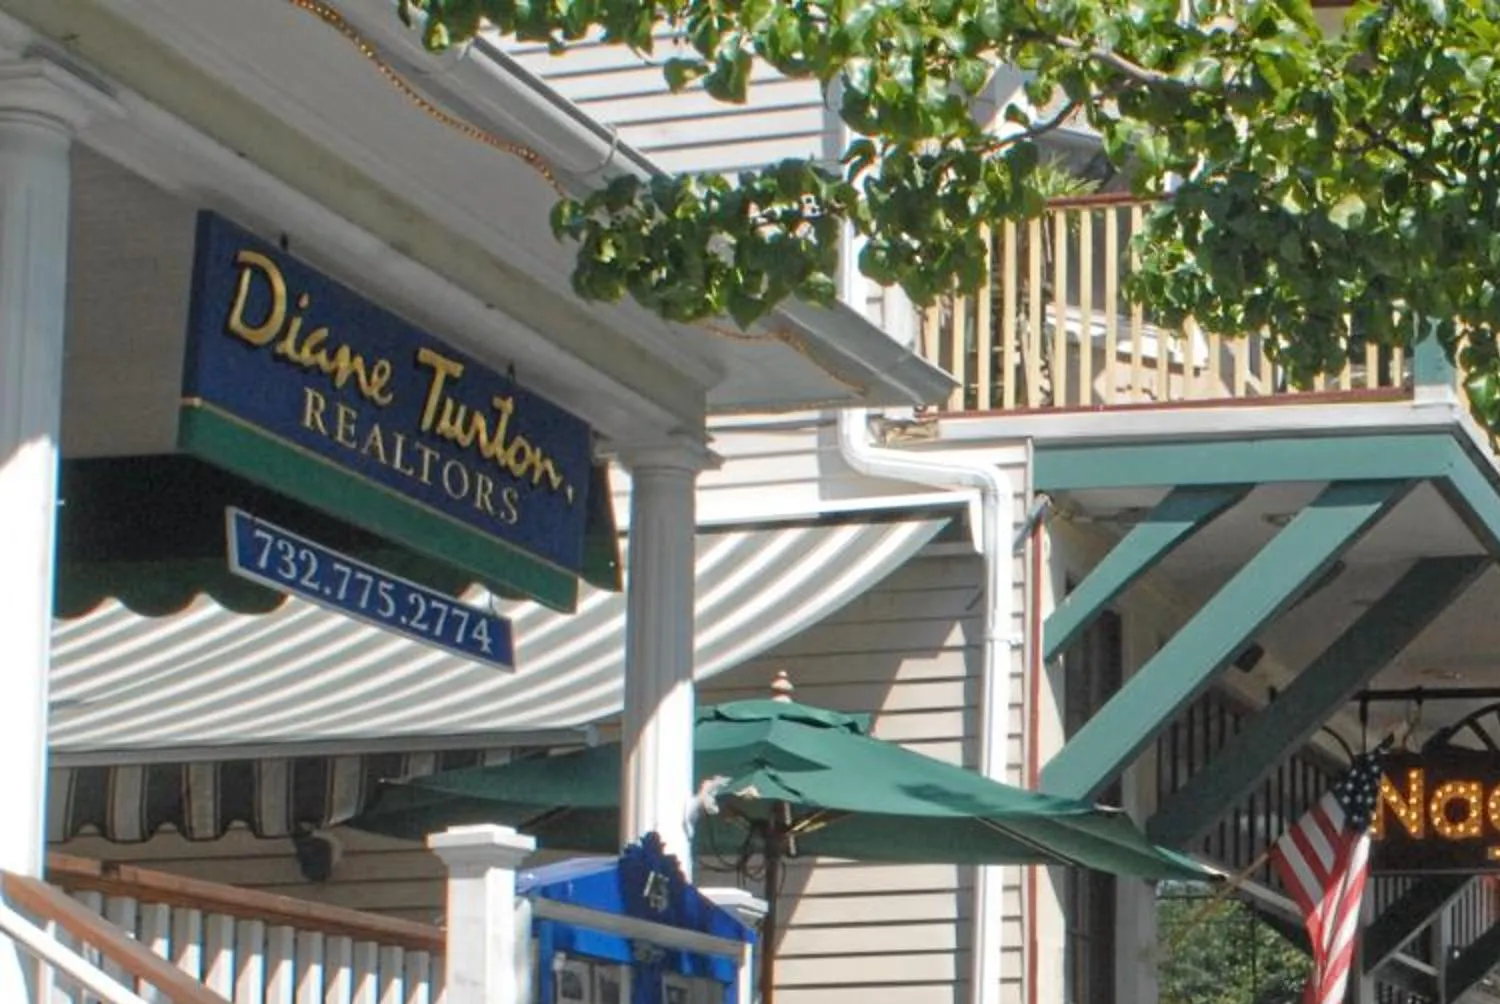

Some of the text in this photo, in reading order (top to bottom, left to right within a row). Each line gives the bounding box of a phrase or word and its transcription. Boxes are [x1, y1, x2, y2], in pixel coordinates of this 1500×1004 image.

[226, 250, 394, 406] Diane
[302, 386, 520, 526] REALTORS
[255, 529, 494, 654] 732.775.2774
